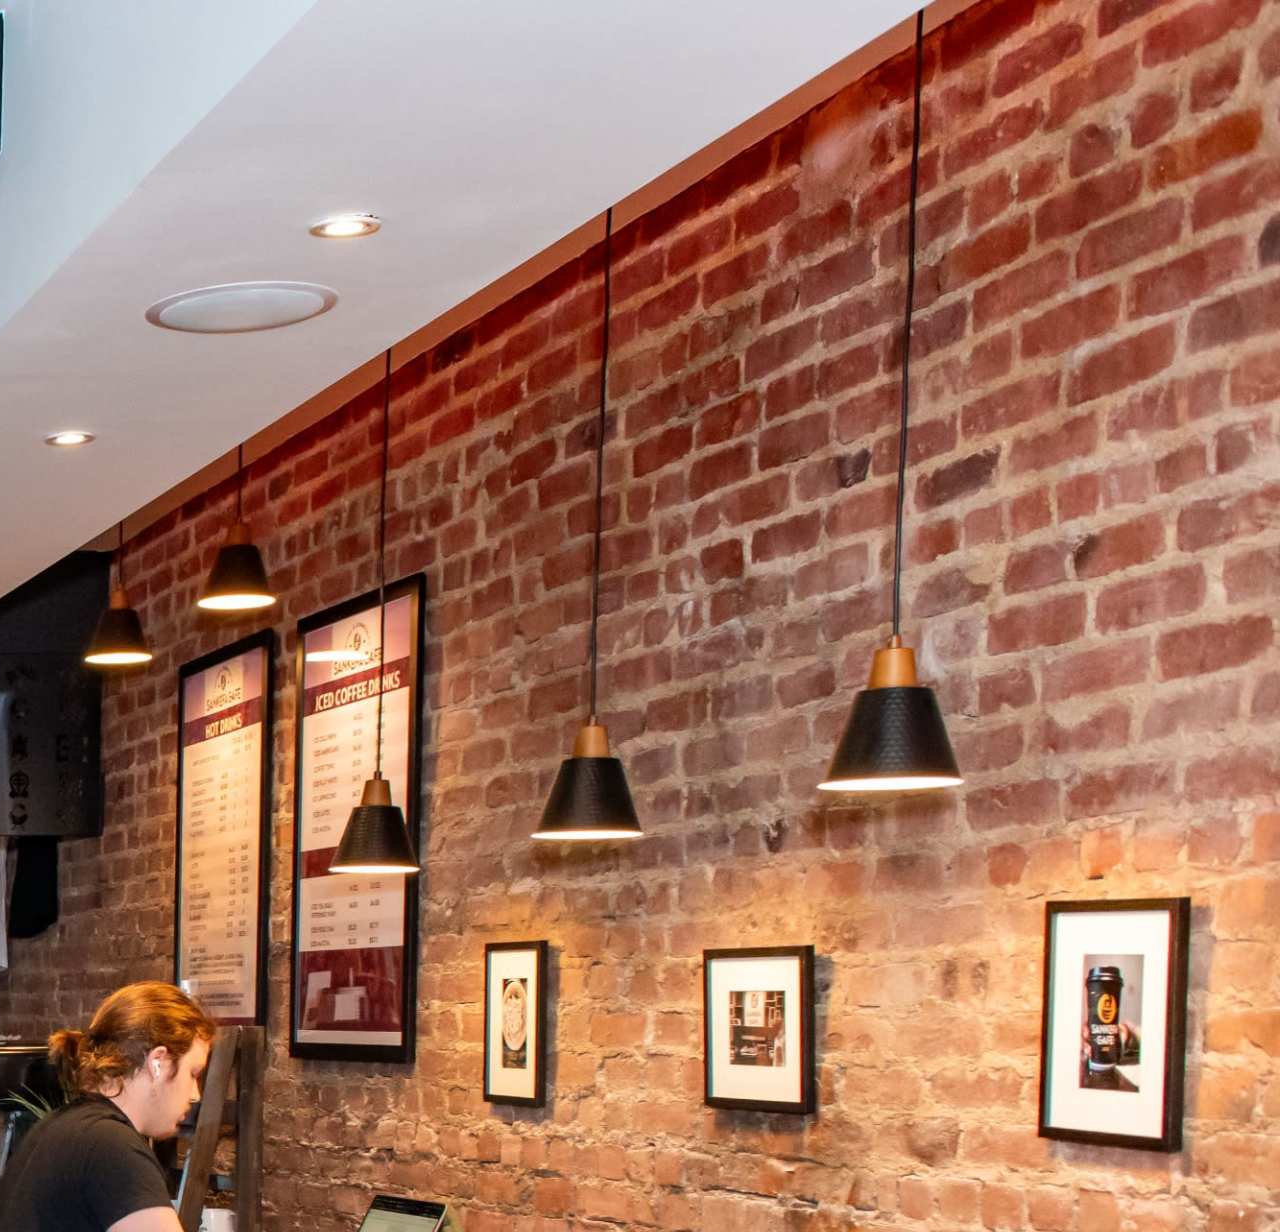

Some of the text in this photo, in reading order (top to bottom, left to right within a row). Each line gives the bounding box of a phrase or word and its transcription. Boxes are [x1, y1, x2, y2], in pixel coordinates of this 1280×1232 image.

[315, 670, 401, 712] ICED COFFEE DRNKS
